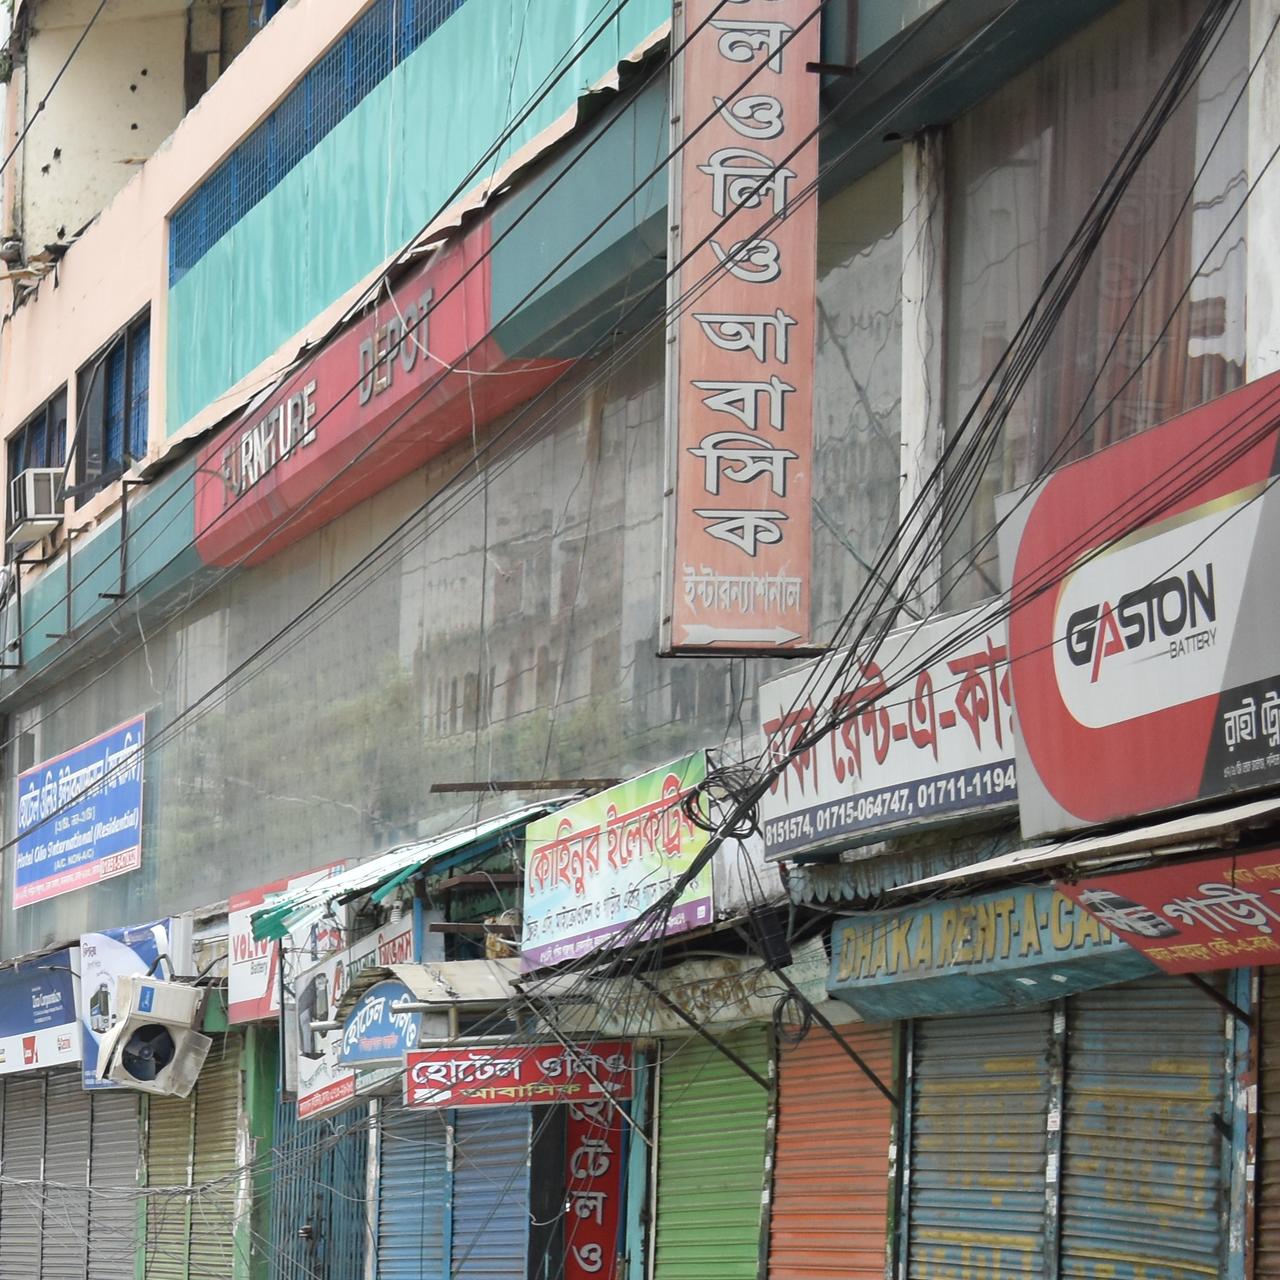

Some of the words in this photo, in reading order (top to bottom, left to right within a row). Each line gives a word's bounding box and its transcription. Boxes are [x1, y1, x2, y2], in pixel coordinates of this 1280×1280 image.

[358, 287, 433, 406] DEPOT
[687, 308, 799, 557] আবাসিক
[1066, 563, 1216, 683] GASTON
[1169, 627, 1216, 659] BATTERY
[766, 818, 814, 846] 8151574,
[817, 789, 913, 832] 01715-064747,
[233, 935, 268, 962] VOLVO
[837, 905, 933, 983] DHAKA
[344, 996, 386, 1055] হোটেল
[412, 1053, 523, 1084] হোটেল
[459, 1082, 582, 1100] আবাসিক
